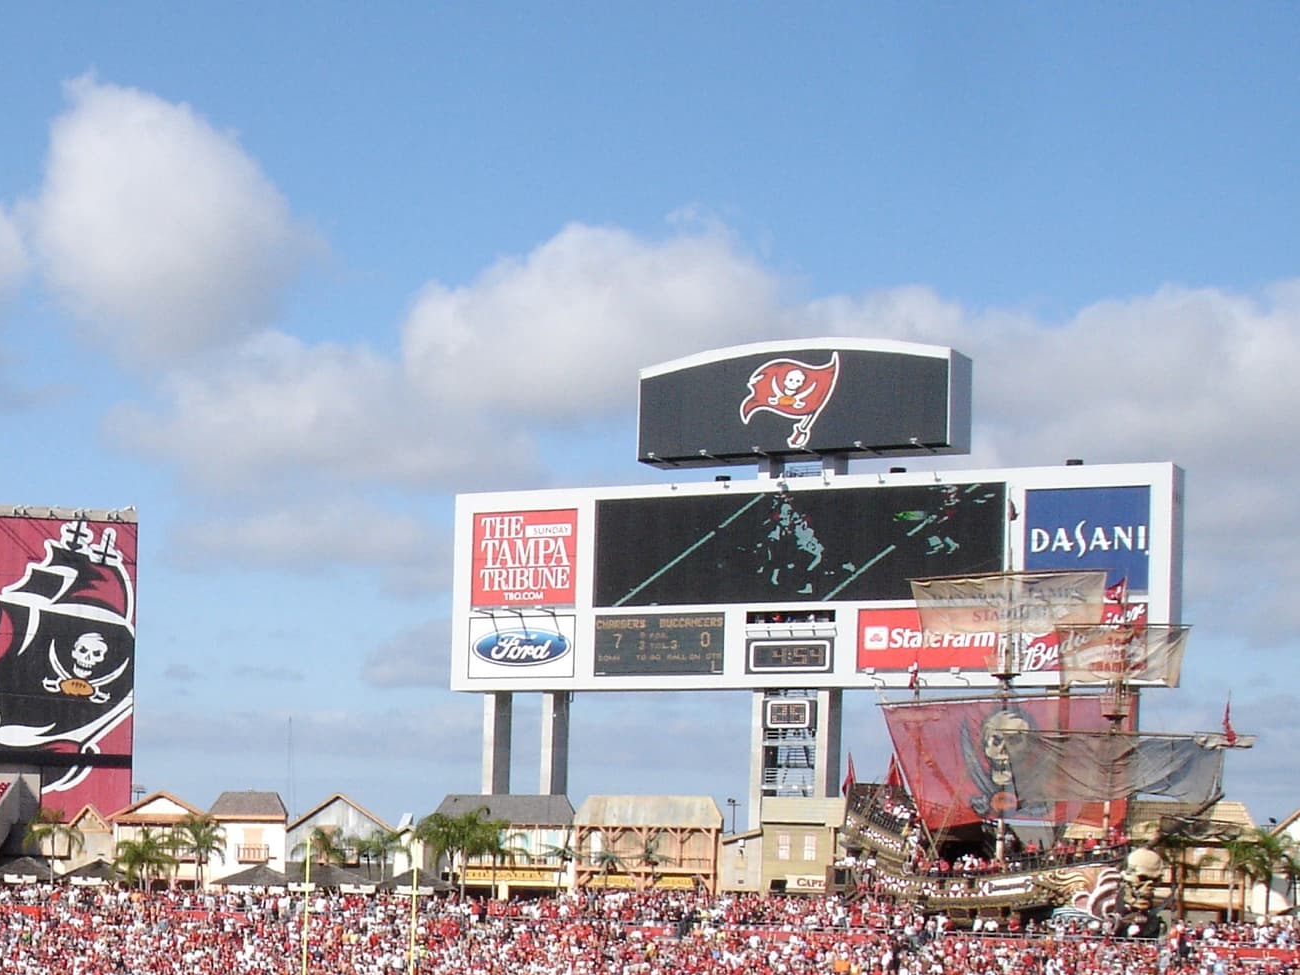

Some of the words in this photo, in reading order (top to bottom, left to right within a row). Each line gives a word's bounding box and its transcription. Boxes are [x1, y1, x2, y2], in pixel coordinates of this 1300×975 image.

[481, 516, 524, 539] THE
[533, 525, 570, 536] SUNDAY
[1031, 520, 1147, 557] DASANI
[481, 537, 570, 568] TAMPA
[480, 566, 570, 591] TRIBUNE
[491, 633, 550, 661] Ford
